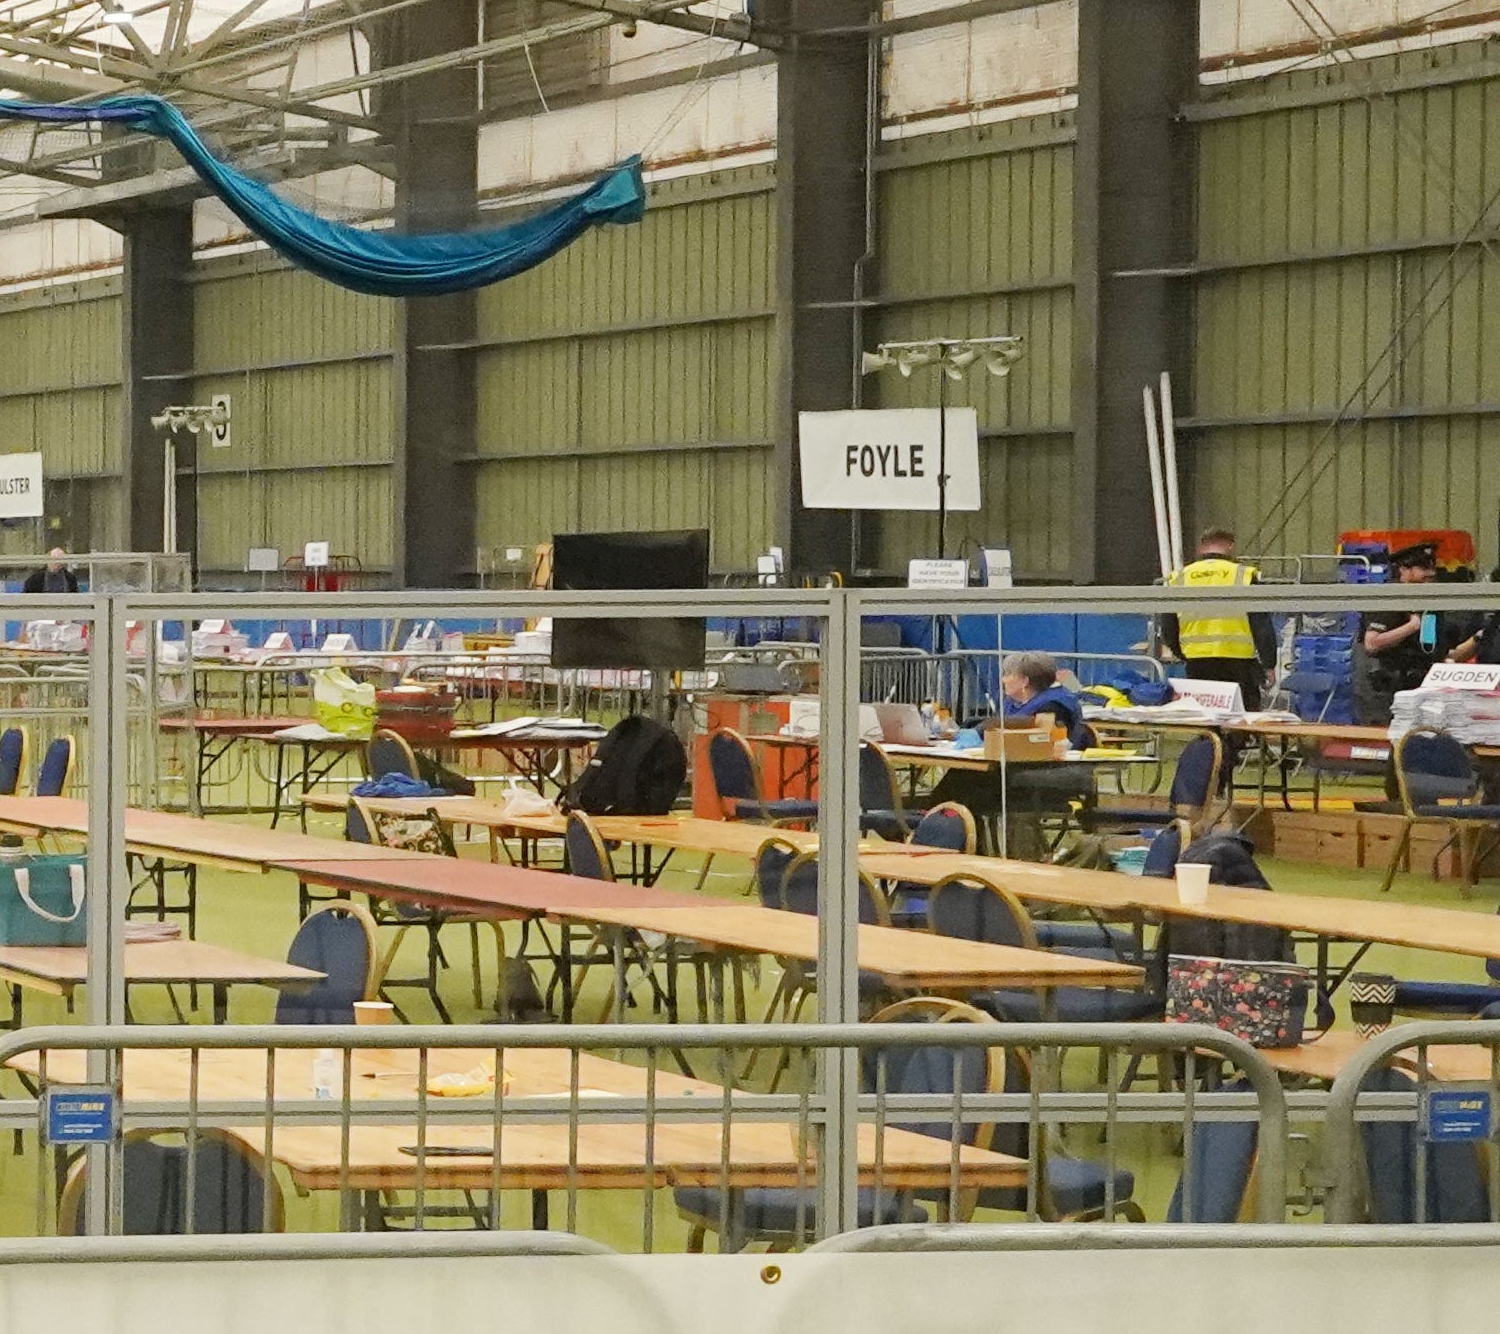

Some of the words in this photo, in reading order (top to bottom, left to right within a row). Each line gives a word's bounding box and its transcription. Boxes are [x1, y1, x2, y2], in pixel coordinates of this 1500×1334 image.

[845, 444, 925, 478] FOYLE
[0, 477, 31, 496] ULSTER
[1428, 670, 1500, 685] SUGDEN
